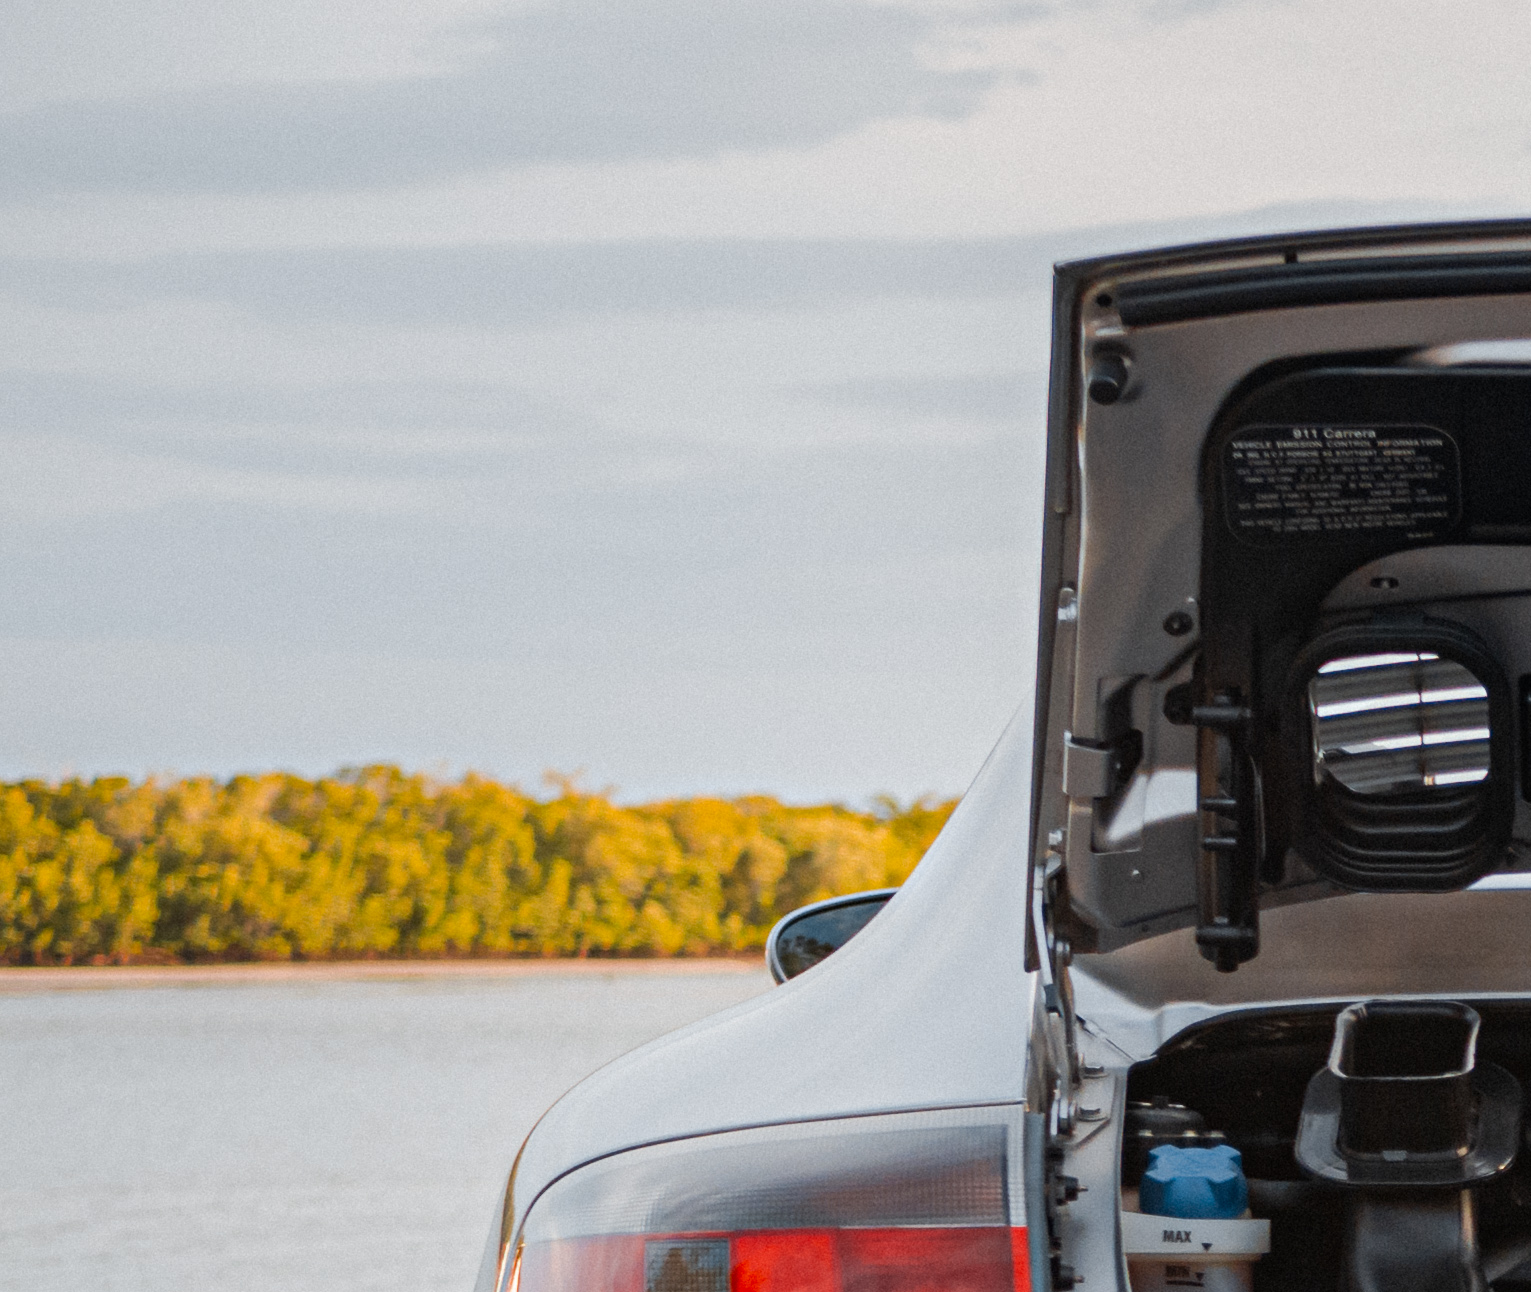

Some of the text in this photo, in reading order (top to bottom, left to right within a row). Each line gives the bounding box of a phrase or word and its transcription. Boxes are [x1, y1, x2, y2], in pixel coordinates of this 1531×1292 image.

[1292, 428, 1376, 439] 911 Carrera
[1232, 438, 1443, 449] VEHICLE EMISSION CONTROL INFORMATION
[1162, 1229, 1192, 1243] MAX
